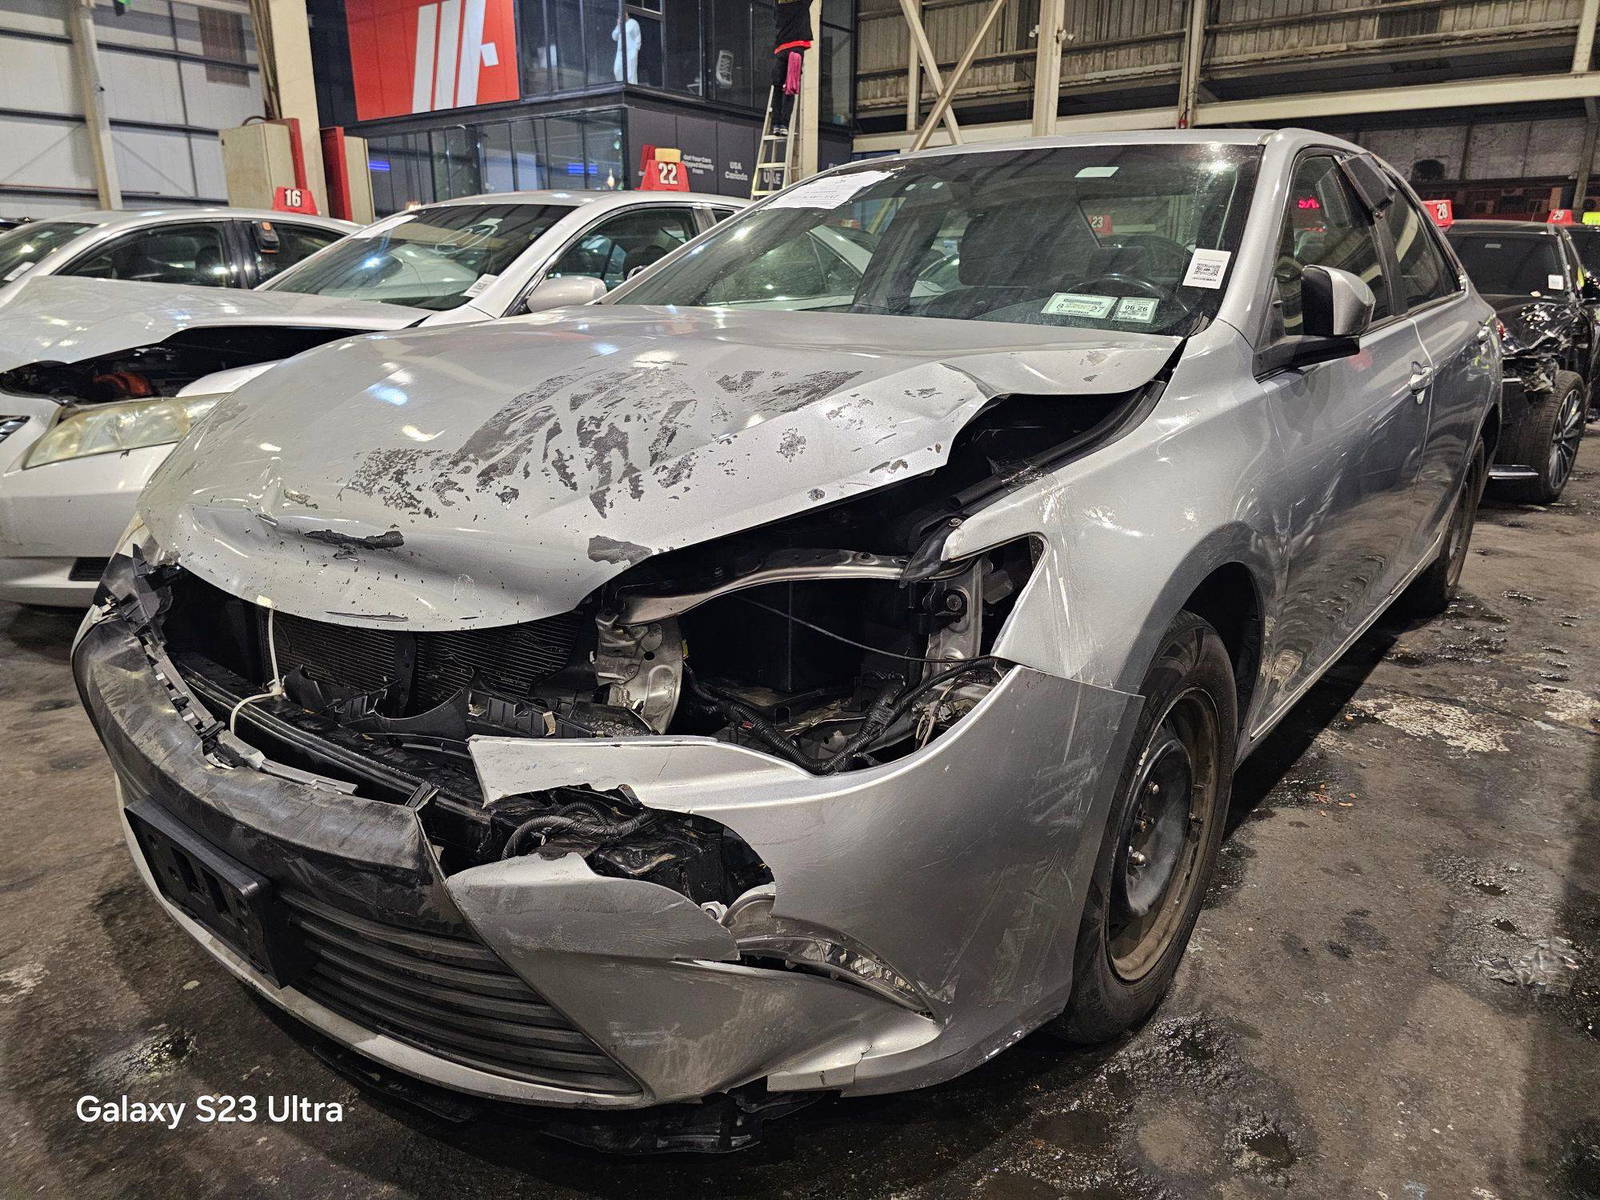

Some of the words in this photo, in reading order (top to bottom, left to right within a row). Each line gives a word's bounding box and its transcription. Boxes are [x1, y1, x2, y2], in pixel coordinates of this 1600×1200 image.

[658, 162, 678, 185] 22
[763, 169, 782, 185] UE
[285, 189, 302, 207] 16
[1091, 215, 1104, 228] 23
